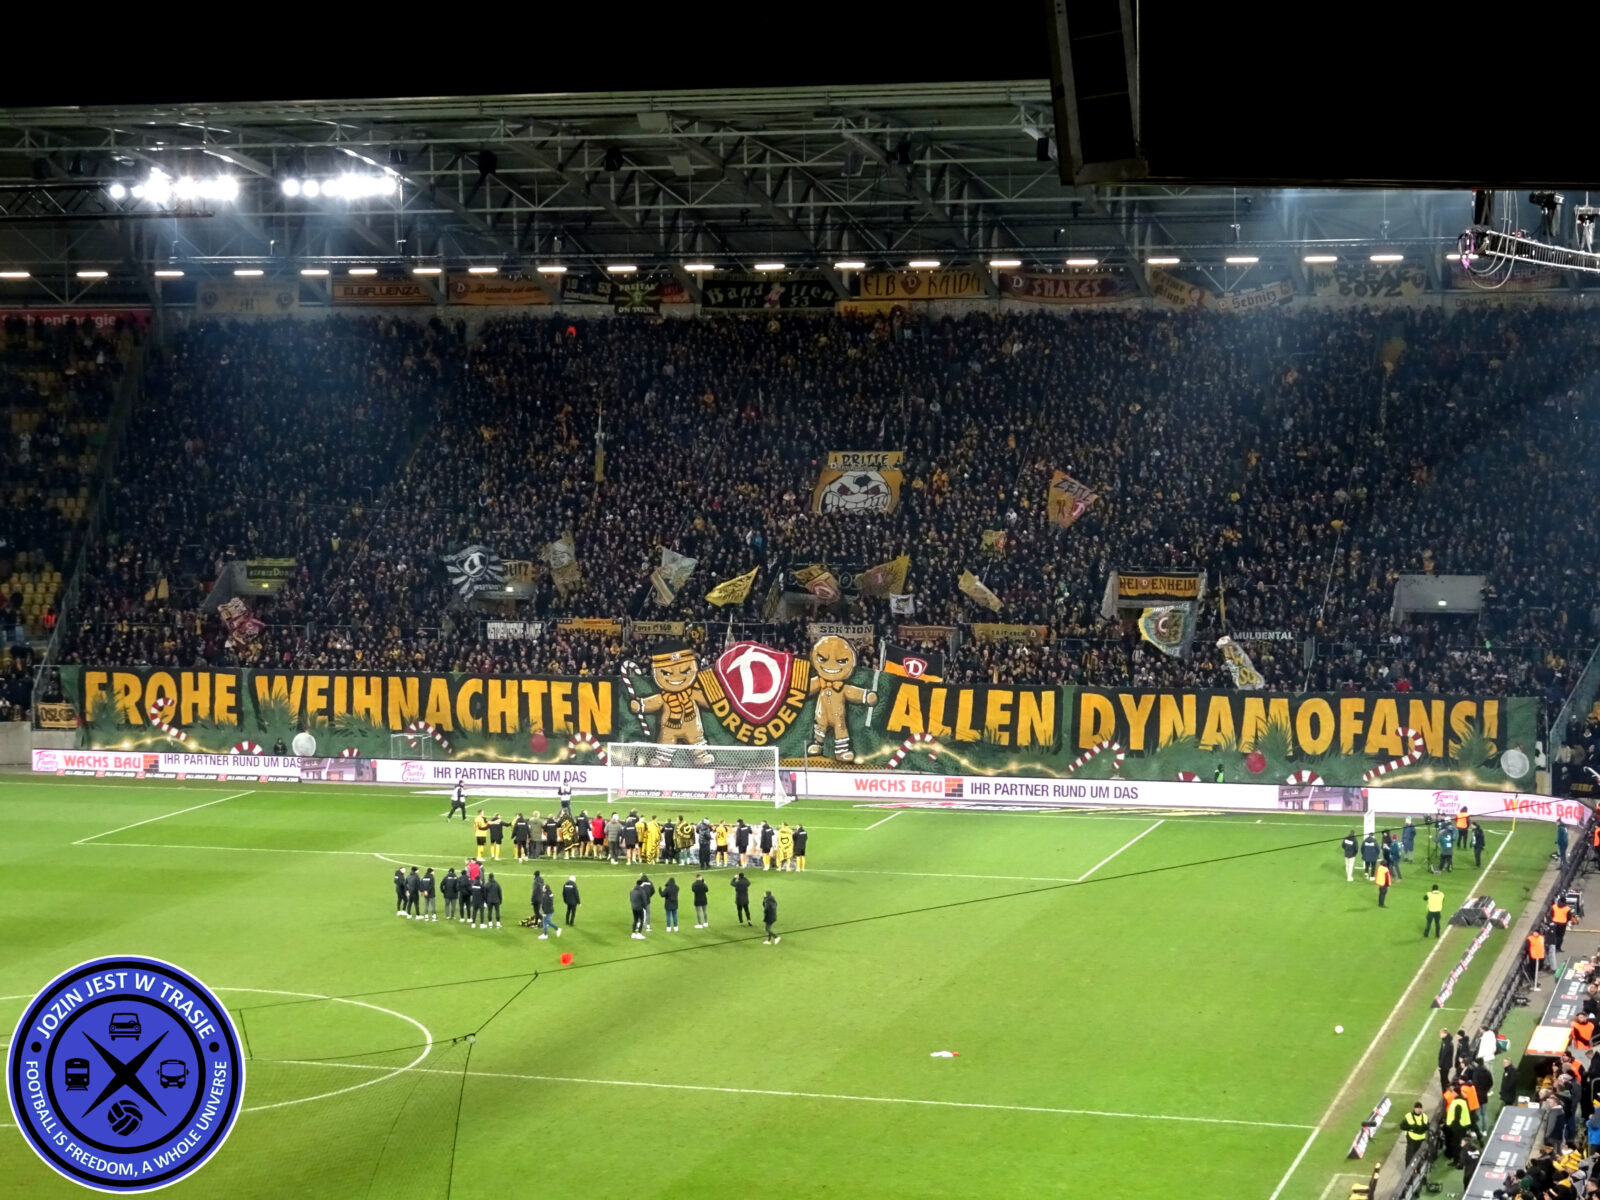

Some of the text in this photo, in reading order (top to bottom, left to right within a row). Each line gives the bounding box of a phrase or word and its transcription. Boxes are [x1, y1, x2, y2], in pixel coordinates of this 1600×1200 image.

[864, 274, 895, 296] ELB
[1032, 279, 1102, 298] SNAKES
[841, 454, 889, 465] DRITTE
[820, 625, 873, 634] SEKTION
[1233, 631, 1294, 640] MULDENTAL
[726, 647, 781, 704] D
[84, 671, 612, 735] FROHE WEIHNACHTEN
[712, 688, 806, 746] DRESDEN
[886, 684, 1055, 747] ALLEN
[64, 754, 109, 769] WACHS
[114, 757, 141, 769] BAU
[164, 754, 181, 765] IHR
[184, 755, 229, 767] PARTNER
[232, 757, 260, 768] RUND
[263, 758, 280, 768] UM
[283, 758, 301, 769] DAS
[433, 766, 587, 783] IHR PARTNER RUND UM DAS
[854, 778, 1139, 800] WACHS BAU IHR PARTNER RUND UM DAS
[1504, 798, 1584, 820] WACHS BAU
